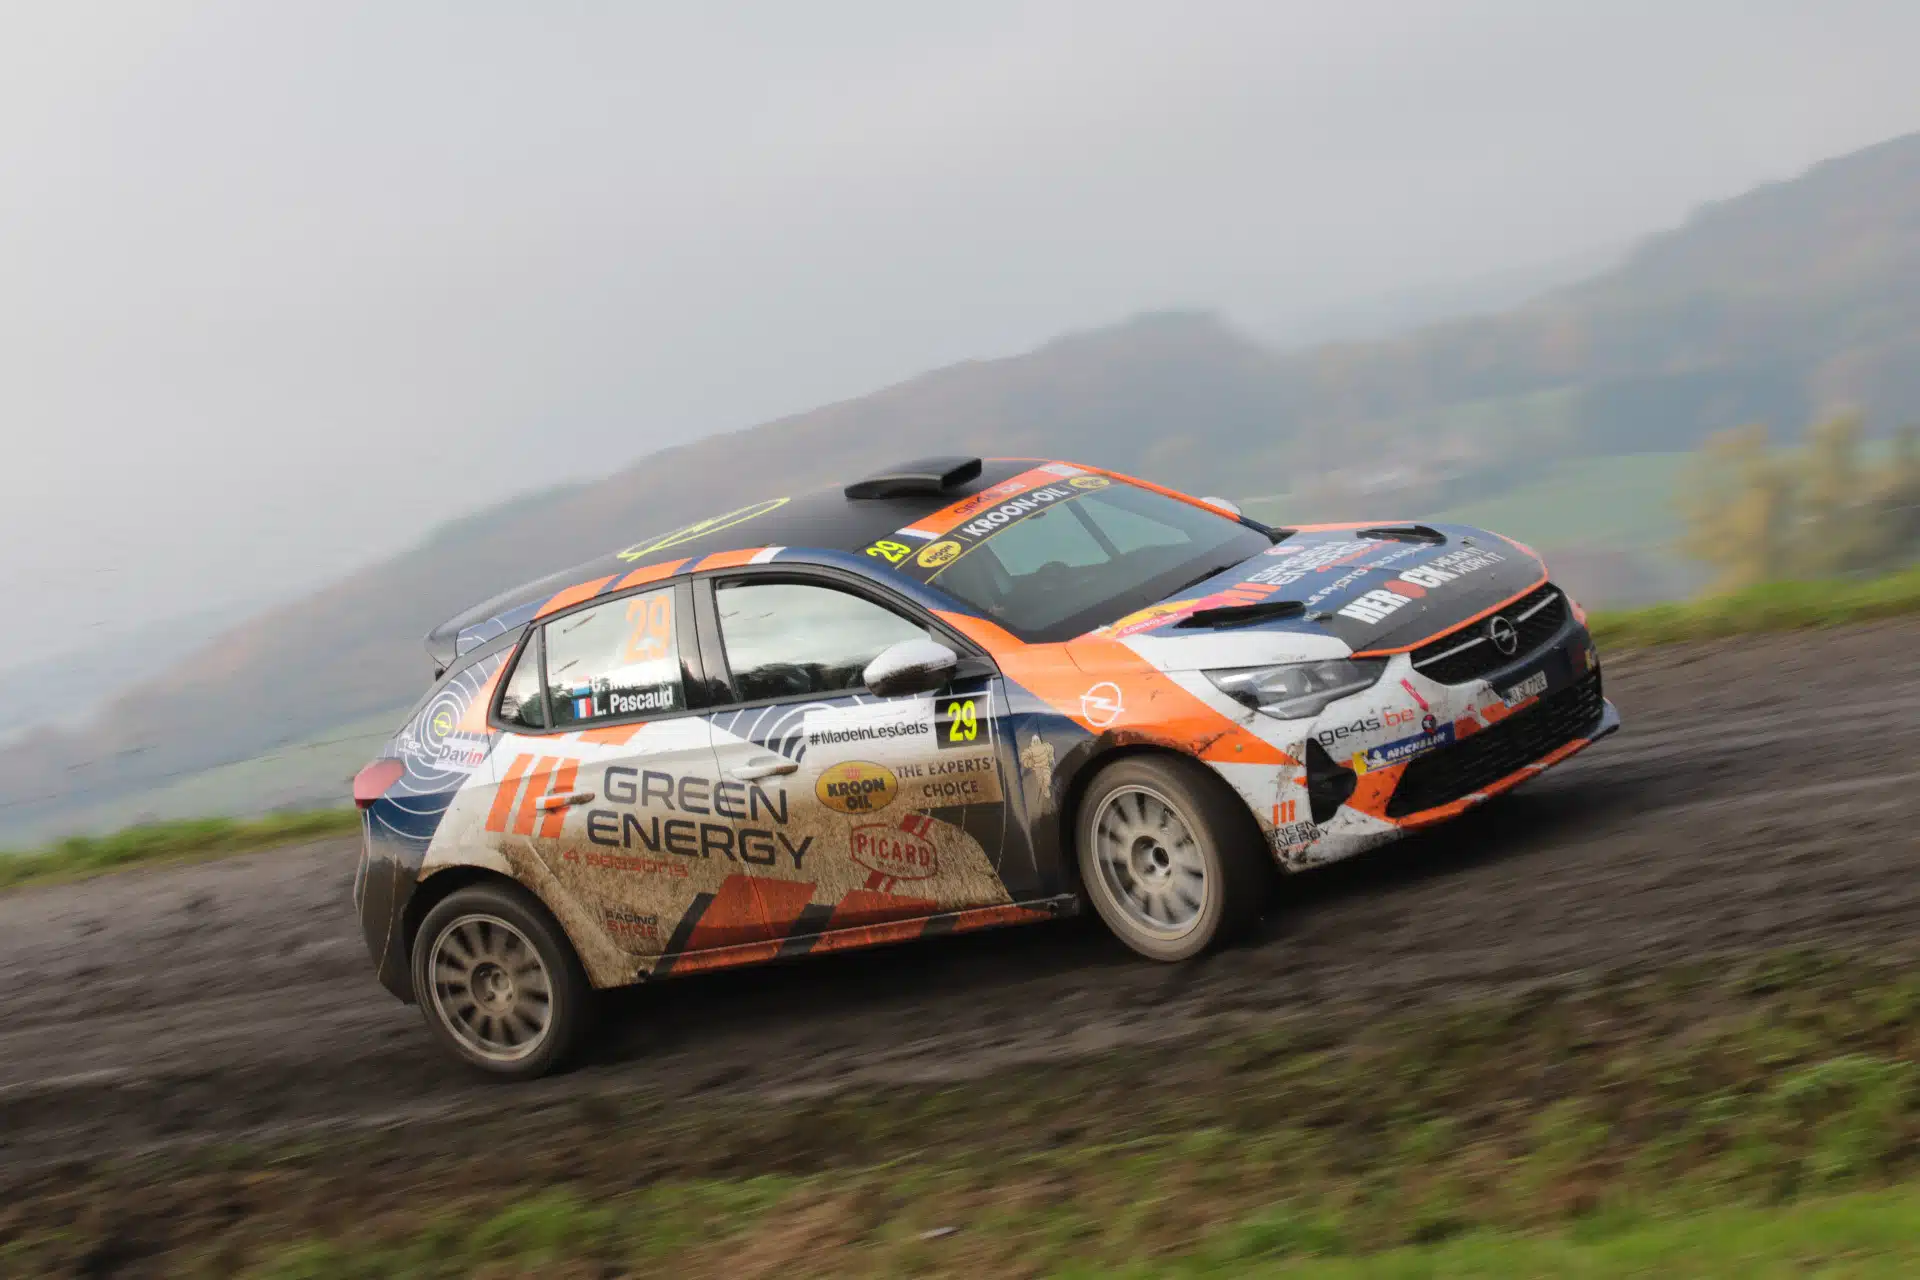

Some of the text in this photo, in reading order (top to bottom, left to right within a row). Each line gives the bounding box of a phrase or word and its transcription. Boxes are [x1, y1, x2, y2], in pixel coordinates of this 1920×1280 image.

[962, 486, 1069, 537] KROON-OIL
[865, 540, 911, 563] 29
[623, 594, 671, 665] 29
[593, 685, 674, 717] L. Pascaud
[809, 721, 929, 746] #MadeInLesGets
[947, 700, 978, 742] 29
[1318, 708, 1415, 747] ge4s.be
[896, 756, 995, 779] THE EXPERTS'
[603, 765, 789, 825] GREEN
[826, 777, 886, 797] KROON
[846, 795, 873, 810] OIL
[922, 780, 979, 799] CHOICE
[586, 809, 815, 870] ENERGY
[856, 832, 931, 867] PICARD
